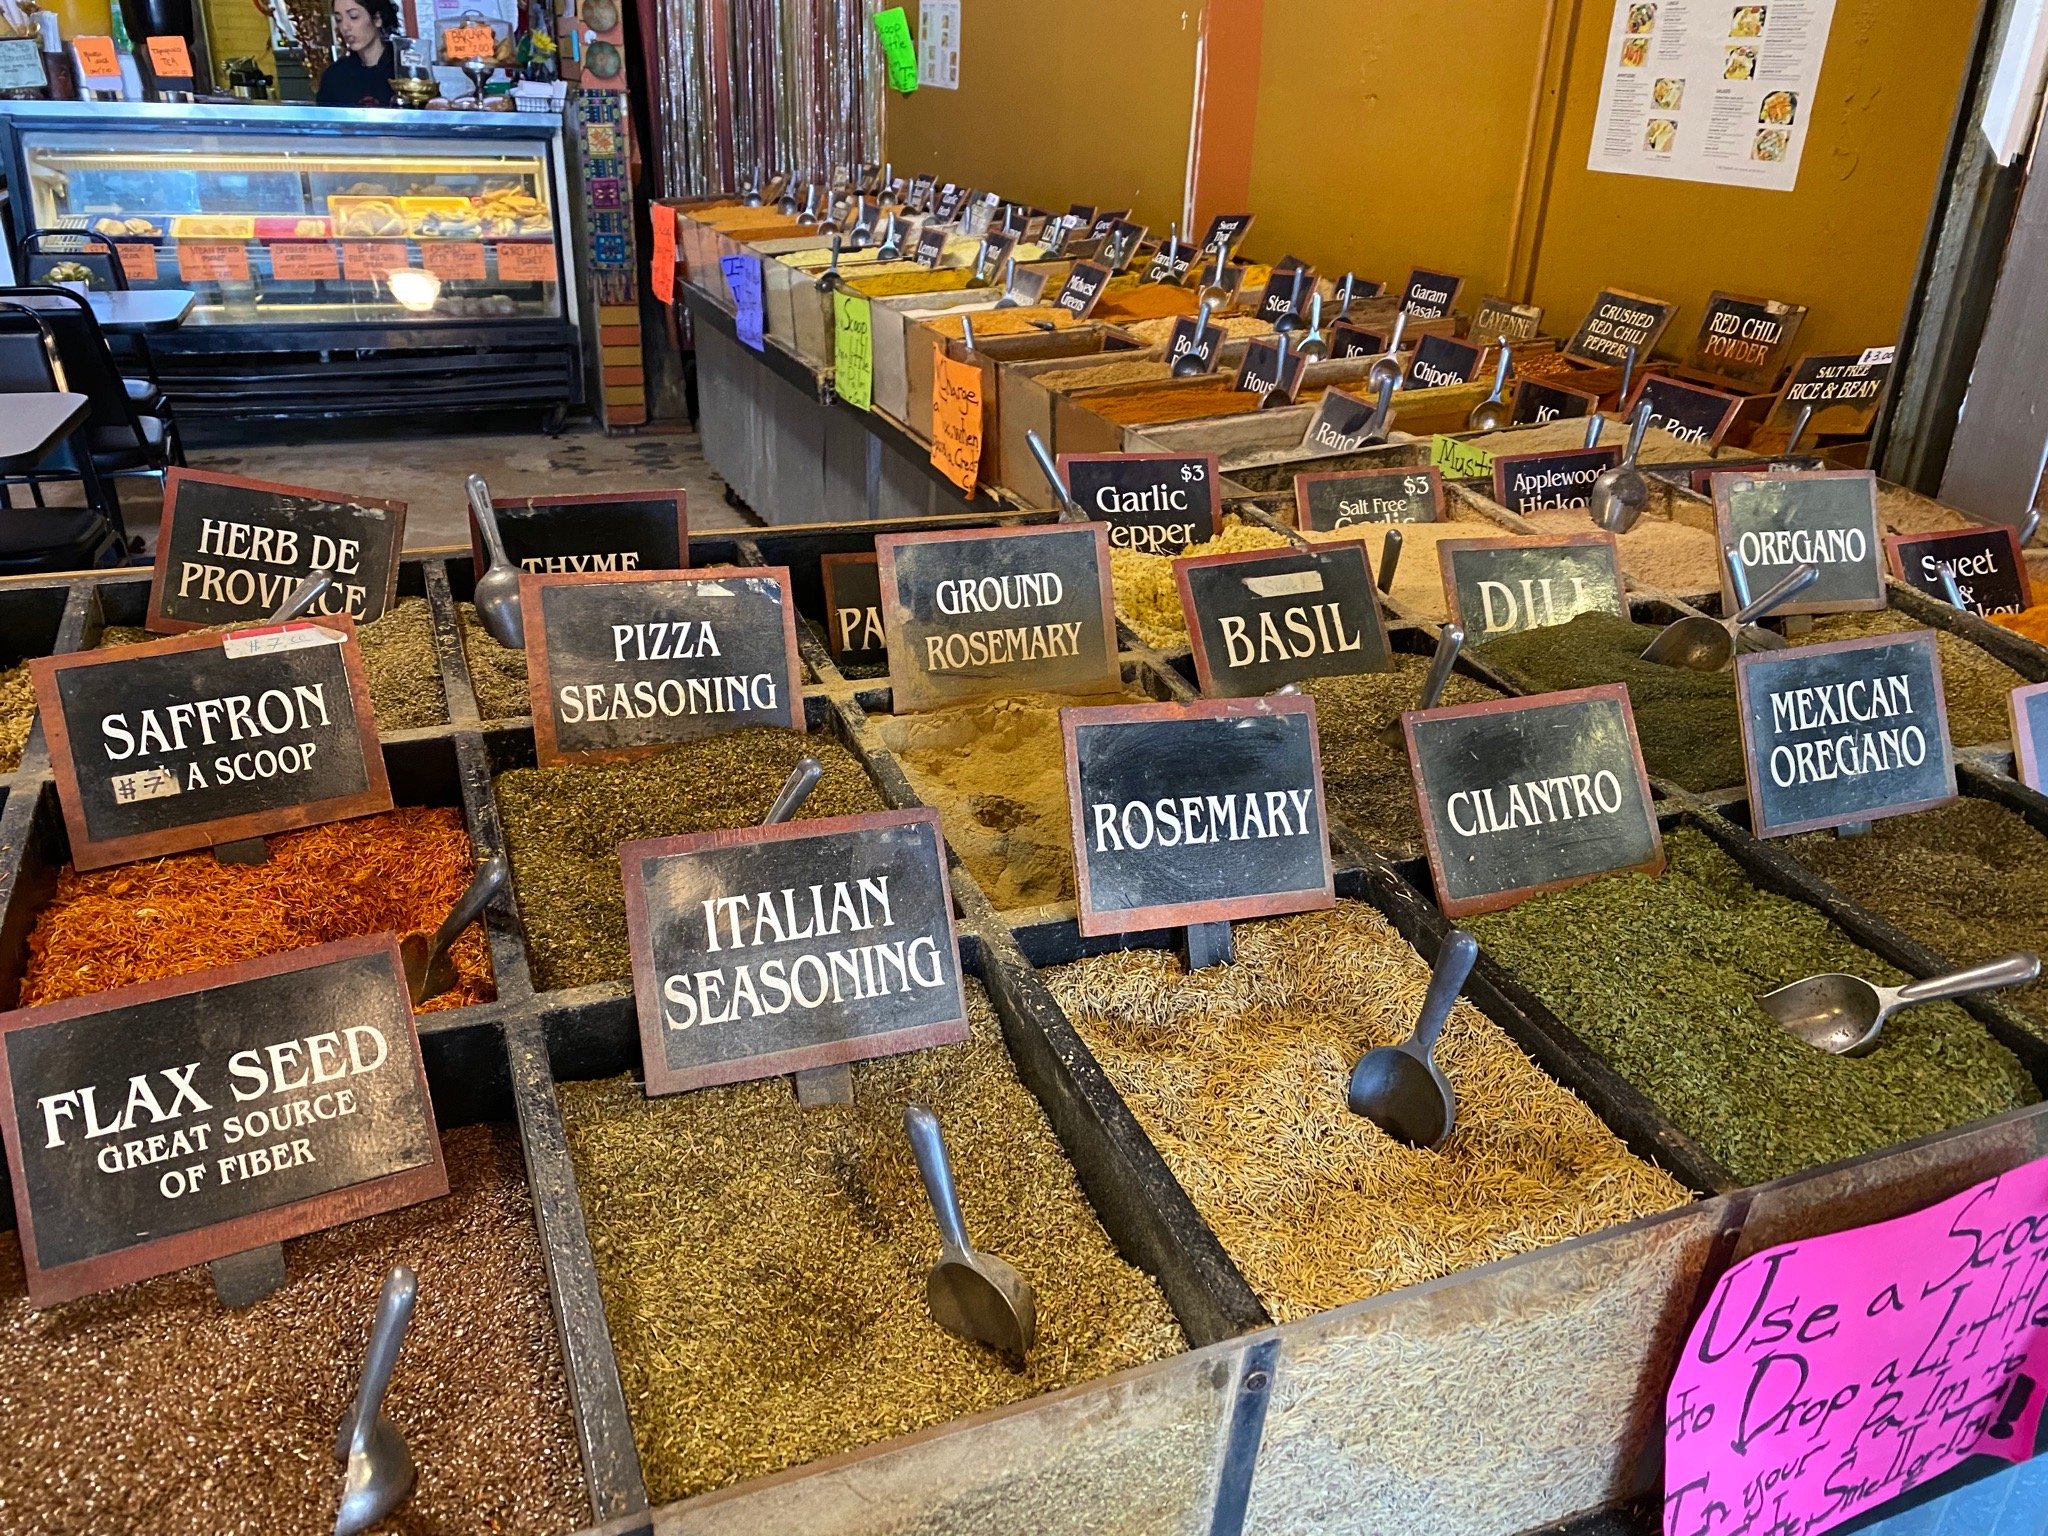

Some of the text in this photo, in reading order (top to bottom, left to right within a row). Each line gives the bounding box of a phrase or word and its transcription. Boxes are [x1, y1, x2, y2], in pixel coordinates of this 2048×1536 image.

[1061, 293, 1086, 311] Greens
[1067, 275, 1098, 296] Midwest
[1266, 295, 1292, 313] Stea
[1411, 284, 1448, 304] Garam
[1405, 301, 1442, 318] Masala
[1478, 308, 1531, 338] CAYENNE
[1600, 304, 1655, 328] CRUSHED
[1709, 312, 1783, 345] RED CHILI
[1588, 318, 1648, 345] RED CHILI
[1704, 334, 1769, 366] POWDER
[1243, 371, 1276, 394] Hous
[1413, 361, 1464, 388] Chipotle
[1787, 379, 1881, 400] RICE & BEAN
[1815, 363, 1872, 379] SALT FREE
[1665, 418, 1708, 445] Pork
[1180, 464, 1205, 482] $3
[1403, 475, 1430, 496] $3
[1096, 483, 1188, 513] Garlic
[1339, 497, 1408, 516] Salt Free
[197, 517, 361, 575] HERB DE
[1739, 527, 1867, 567] OREGANO
[936, 572, 1063, 615] GROUND
[1958, 585, 1976, 605] &
[611, 620, 722, 662] PIZZA
[925, 621, 1083, 671] ROSEMARY
[1218, 602, 1361, 668] BASIL
[560, 672, 778, 724] SEASONING
[1769, 674, 1914, 734] MEXICAN
[101, 683, 332, 761] SAFFRON
[186, 742, 317, 791] A SCOOP
[1770, 725, 1926, 788] OREGANO
[1091, 788, 1313, 853] ROSEMARY
[1447, 769, 1623, 837] CILANTRO
[701, 875, 895, 953] ITALIAN
[664, 935, 946, 1031] SEASONING
[37, 1025, 388, 1149] FLAX SEED
[98, 1088, 358, 1175] GREAT SOURCE
[159, 1138, 316, 1199] OF FIBER
[1699, 1247, 1840, 1364] Use
[1866, 1283, 1906, 1317] a
[1666, 1385, 1716, 1442] to
[1731, 1350, 1862, 1457] Drop
[1871, 1358, 1903, 1389] a
[1743, 1440, 1832, 1522] your
